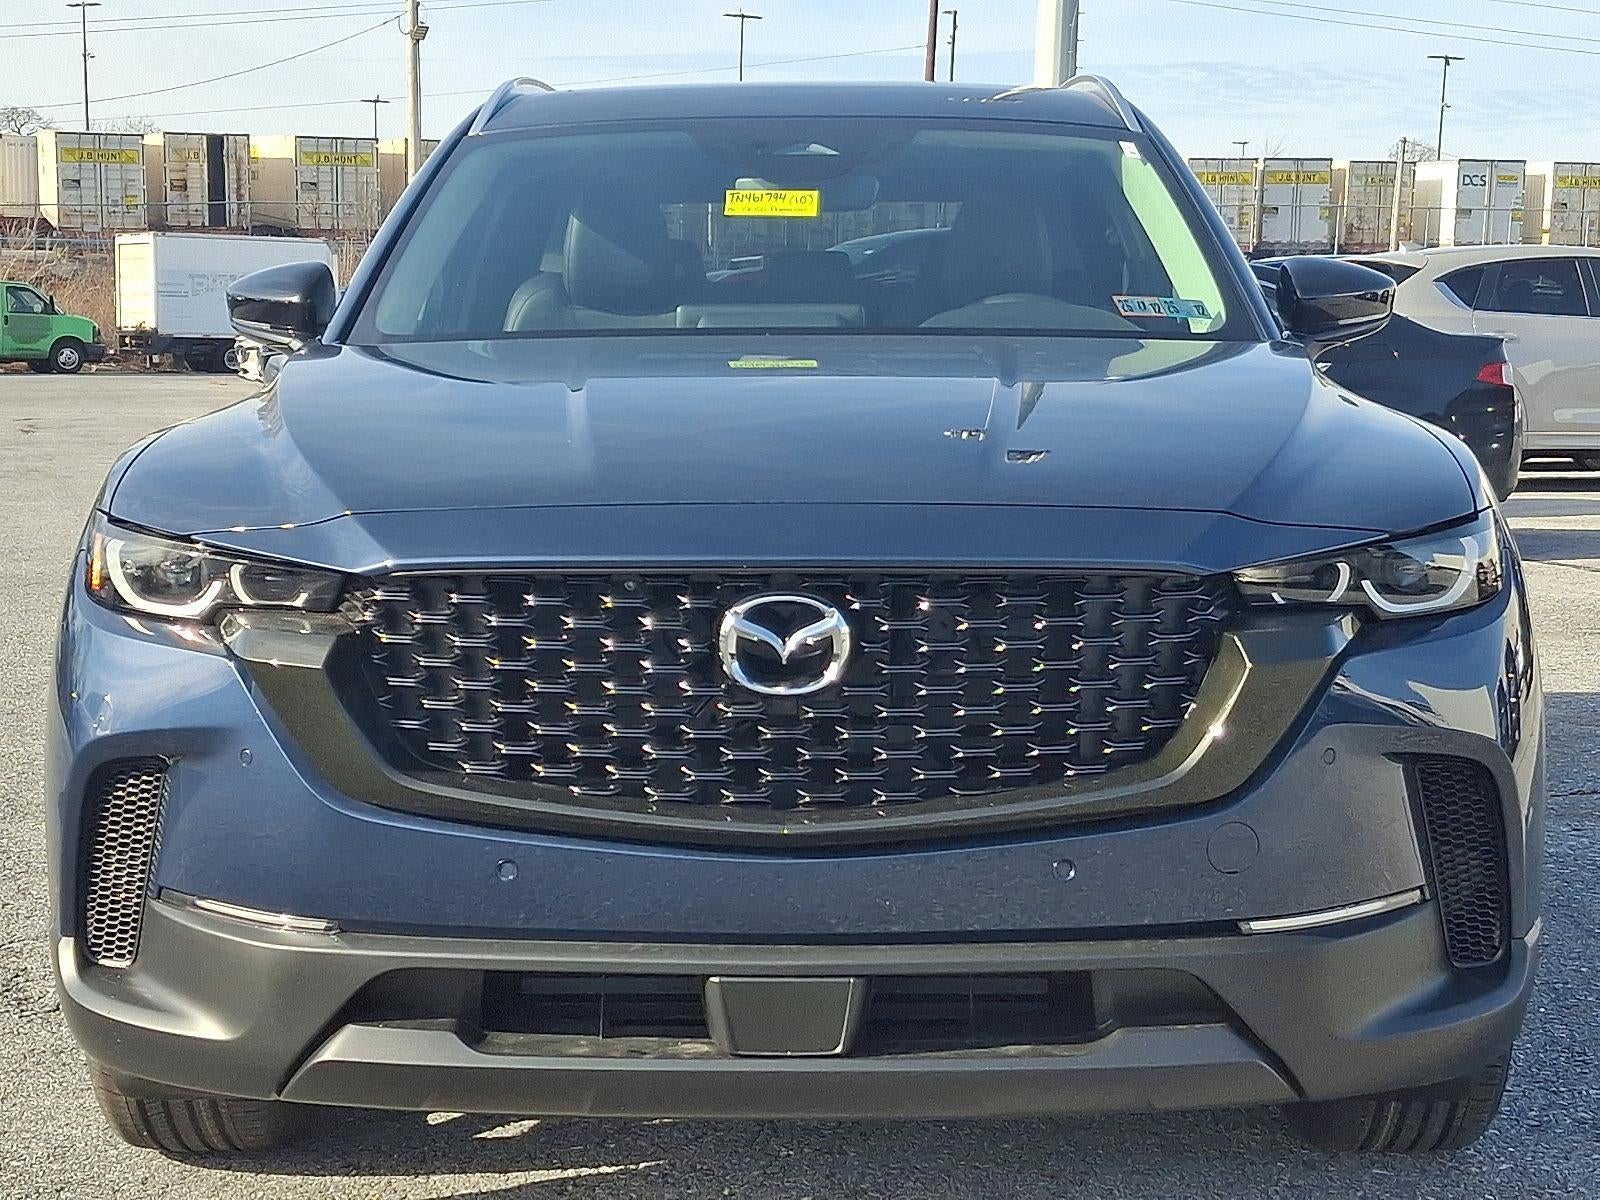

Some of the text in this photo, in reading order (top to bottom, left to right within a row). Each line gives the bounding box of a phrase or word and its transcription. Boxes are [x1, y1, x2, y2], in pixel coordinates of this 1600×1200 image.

[334, 155, 358, 164] HUNT
[1462, 174, 1487, 187] DCS
[729, 192, 814, 206] TN461794 (10)
